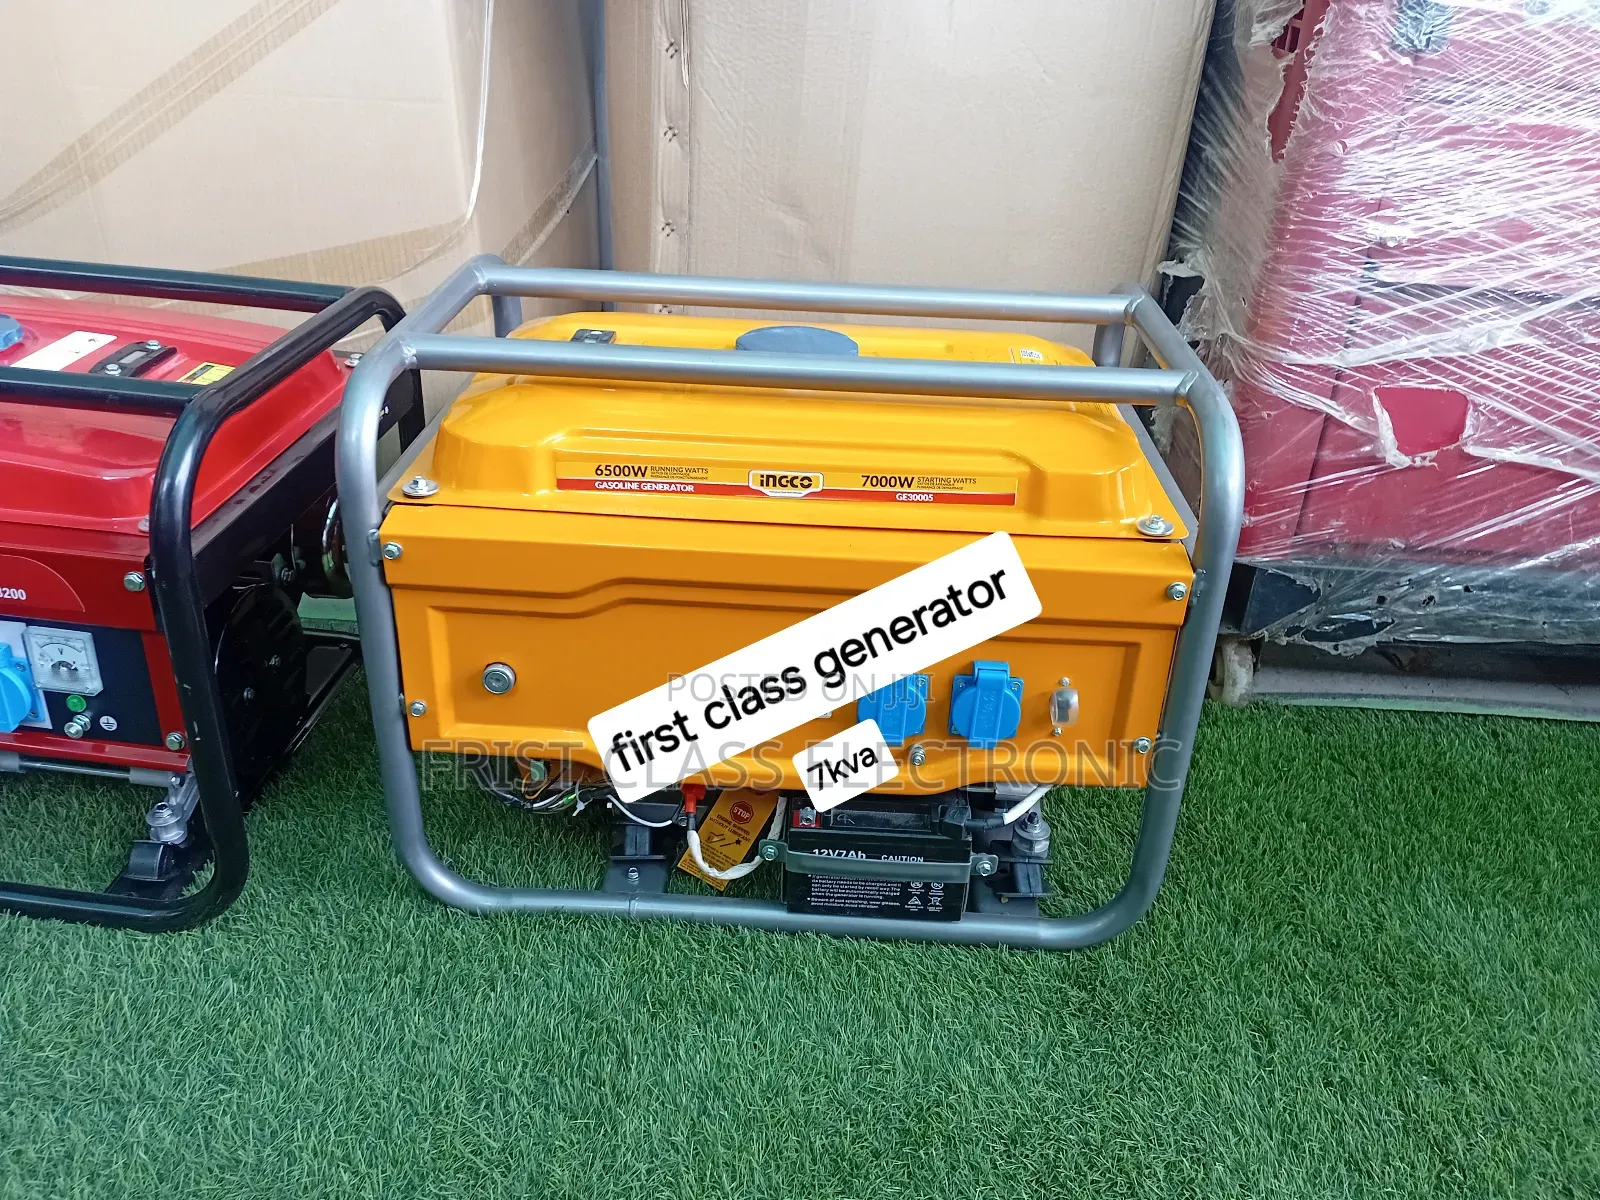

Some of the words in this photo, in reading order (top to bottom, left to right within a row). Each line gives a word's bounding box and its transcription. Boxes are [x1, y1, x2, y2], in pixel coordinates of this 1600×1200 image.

[594, 464, 648, 478] 6500W
[650, 465, 683, 473] RUNNING
[684, 467, 709, 475] WATTS
[594, 481, 640, 490] GASOLINE
[640, 482, 695, 492] GENERATOR
[861, 475, 915, 489] 7000W
[917, 476, 951, 484] STARTING
[952, 477, 977, 485] WATTS
[895, 493, 934, 502] GE30005
[733, 806, 751, 820] STOP
[812, 848, 867, 860] 12V7Ah
[881, 854, 924, 863] CAUTION
